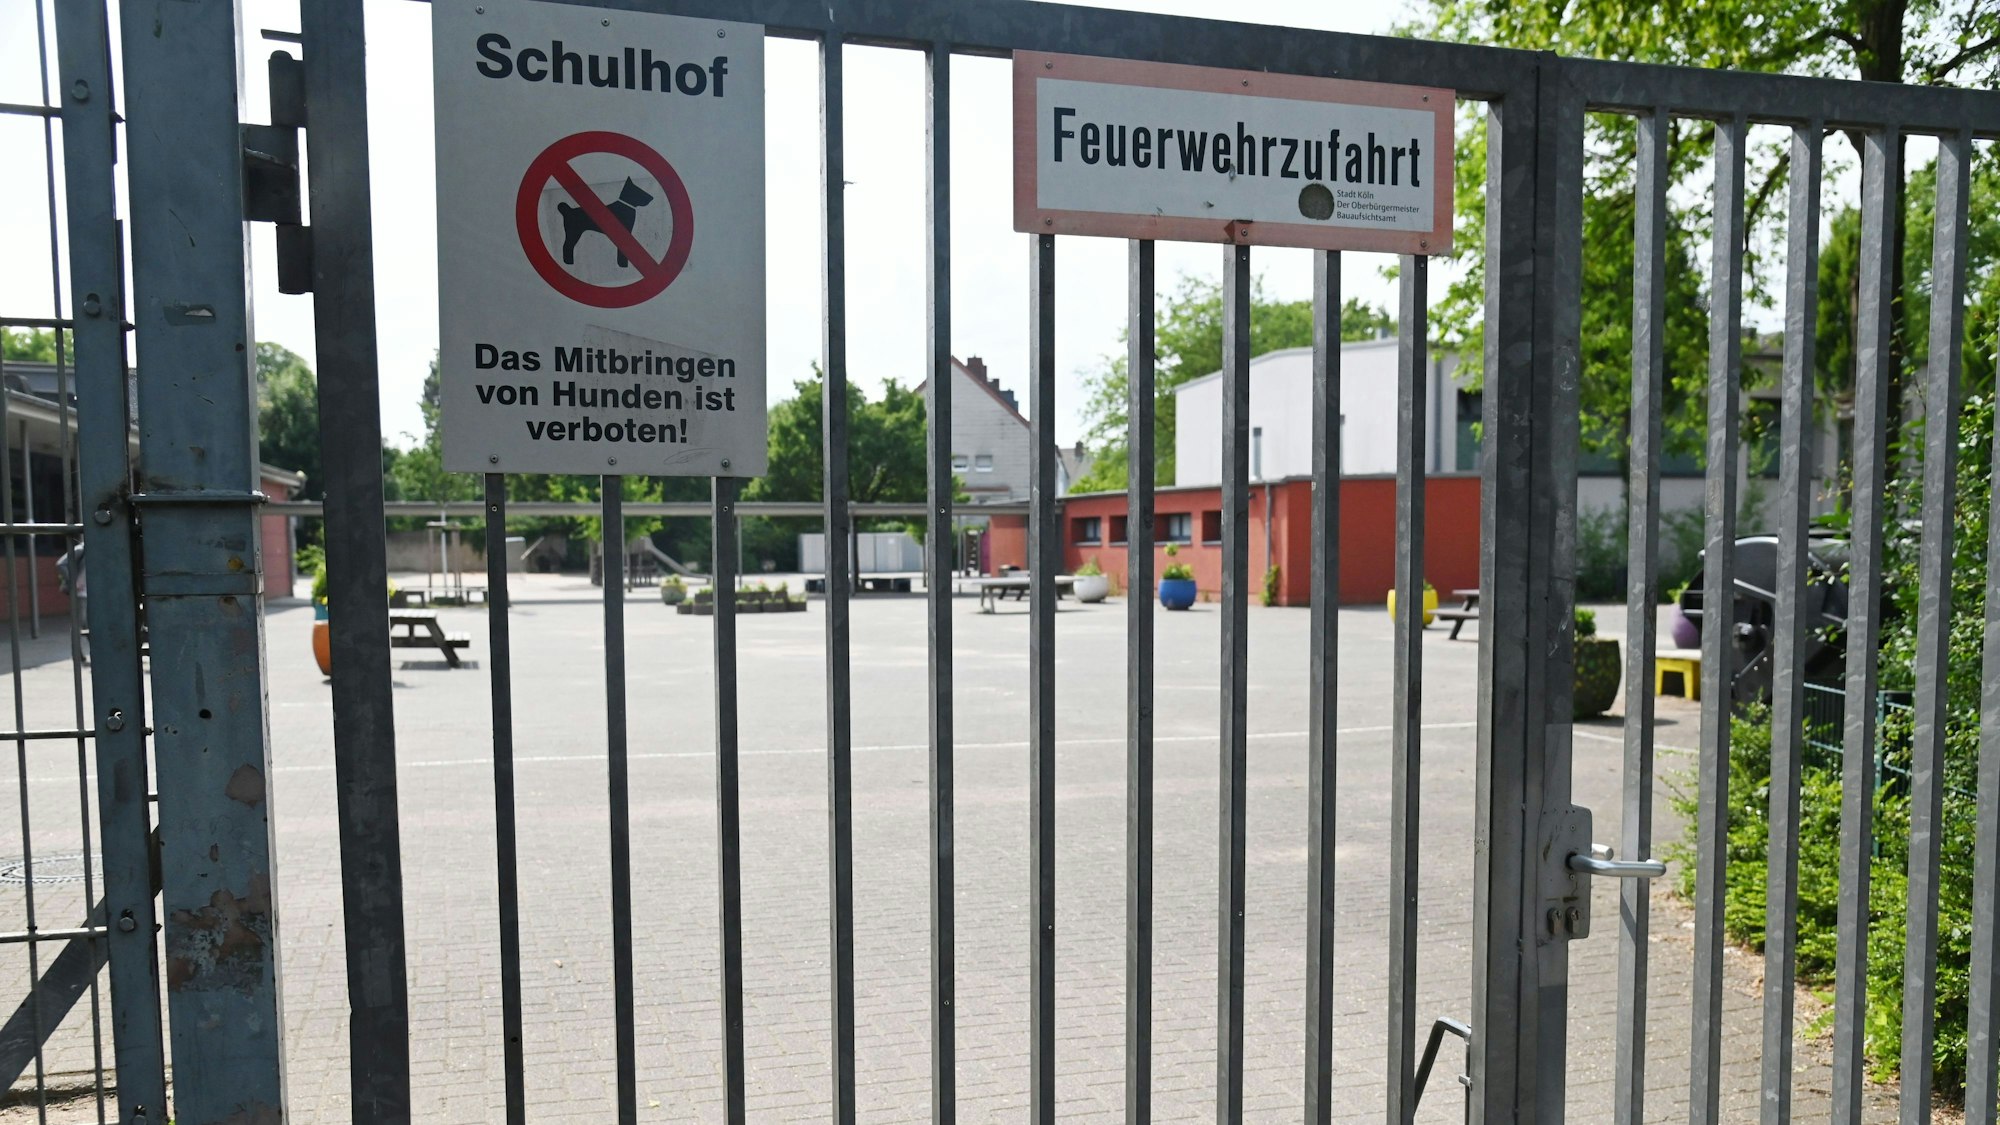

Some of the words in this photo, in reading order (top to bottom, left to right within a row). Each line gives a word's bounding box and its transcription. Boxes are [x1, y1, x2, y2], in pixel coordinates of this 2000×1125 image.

[476, 33, 728, 97] Schulhof
[1054, 107, 1420, 187] Feuerwehrzufahrt
[1337, 190, 1356, 198] Stadt
[1358, 191, 1374, 199] Köln
[1337, 201, 1350, 209] Der
[1351, 201, 1420, 213] Oberbürgermeister
[1337, 212, 1396, 222] Bauaufsichtsamt
[475, 343, 541, 372] Das
[554, 346, 735, 383] Mitbringen
[475, 384, 539, 406] von
[553, 381, 682, 410] Hunden
[696, 386, 735, 412] ist
[526, 417, 687, 443] verboten!
